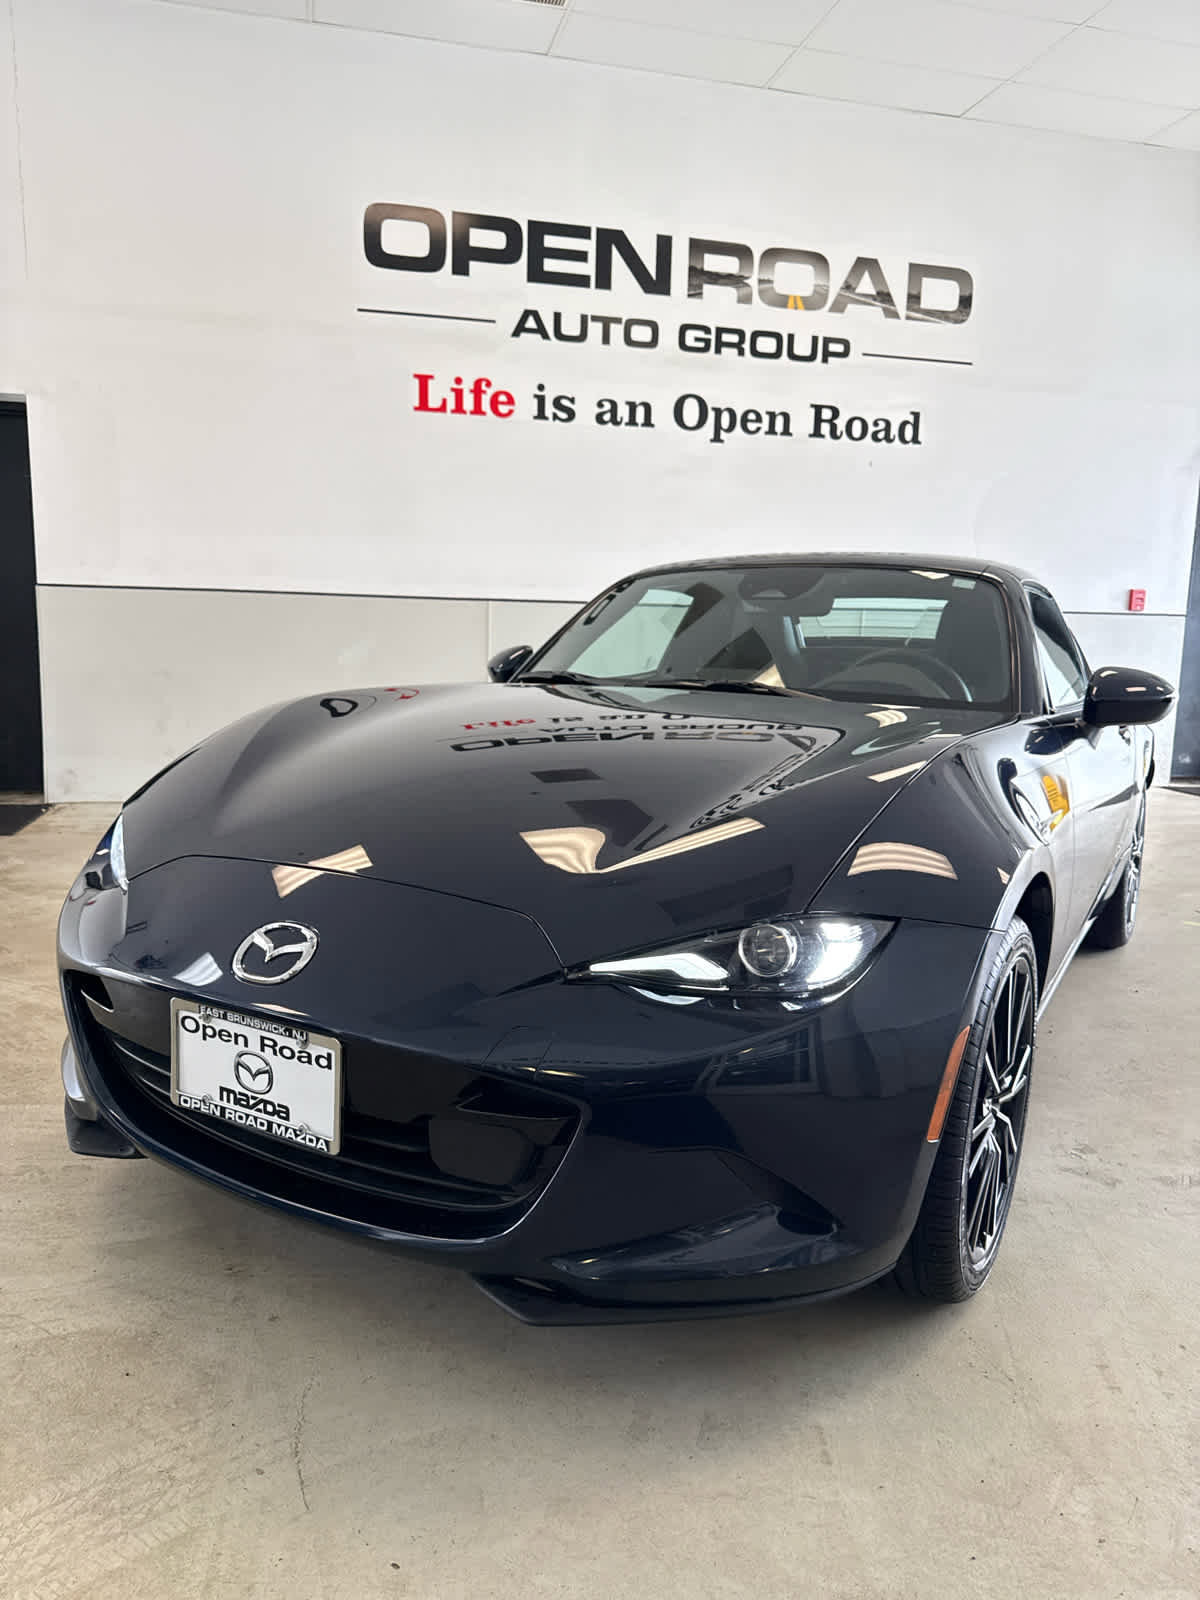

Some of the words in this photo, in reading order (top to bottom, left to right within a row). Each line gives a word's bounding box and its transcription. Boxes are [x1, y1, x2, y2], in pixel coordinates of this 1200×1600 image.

[363, 202, 673, 297] OPEN
[686, 236, 974, 326] ROAD
[511, 308, 660, 349] AUTO
[678, 323, 851, 365] GROUP
[412, 373, 516, 419] Life
[532, 383, 576, 424] is
[594, 398, 655, 429] an
[673, 392, 793, 444] Open
[807, 403, 923, 445] Road
[181, 1015, 249, 1048] Open
[260, 1035, 332, 1070] Road
[200, 1005, 225, 1020] EAST
[227, 1013, 290, 1036] BRUNSWICK,
[292, 1030, 308, 1041] NJ
[180, 1096, 221, 1116] OPEN
[224, 1110, 269, 1131] ROAD
[273, 1124, 328, 1151] MAZDA
